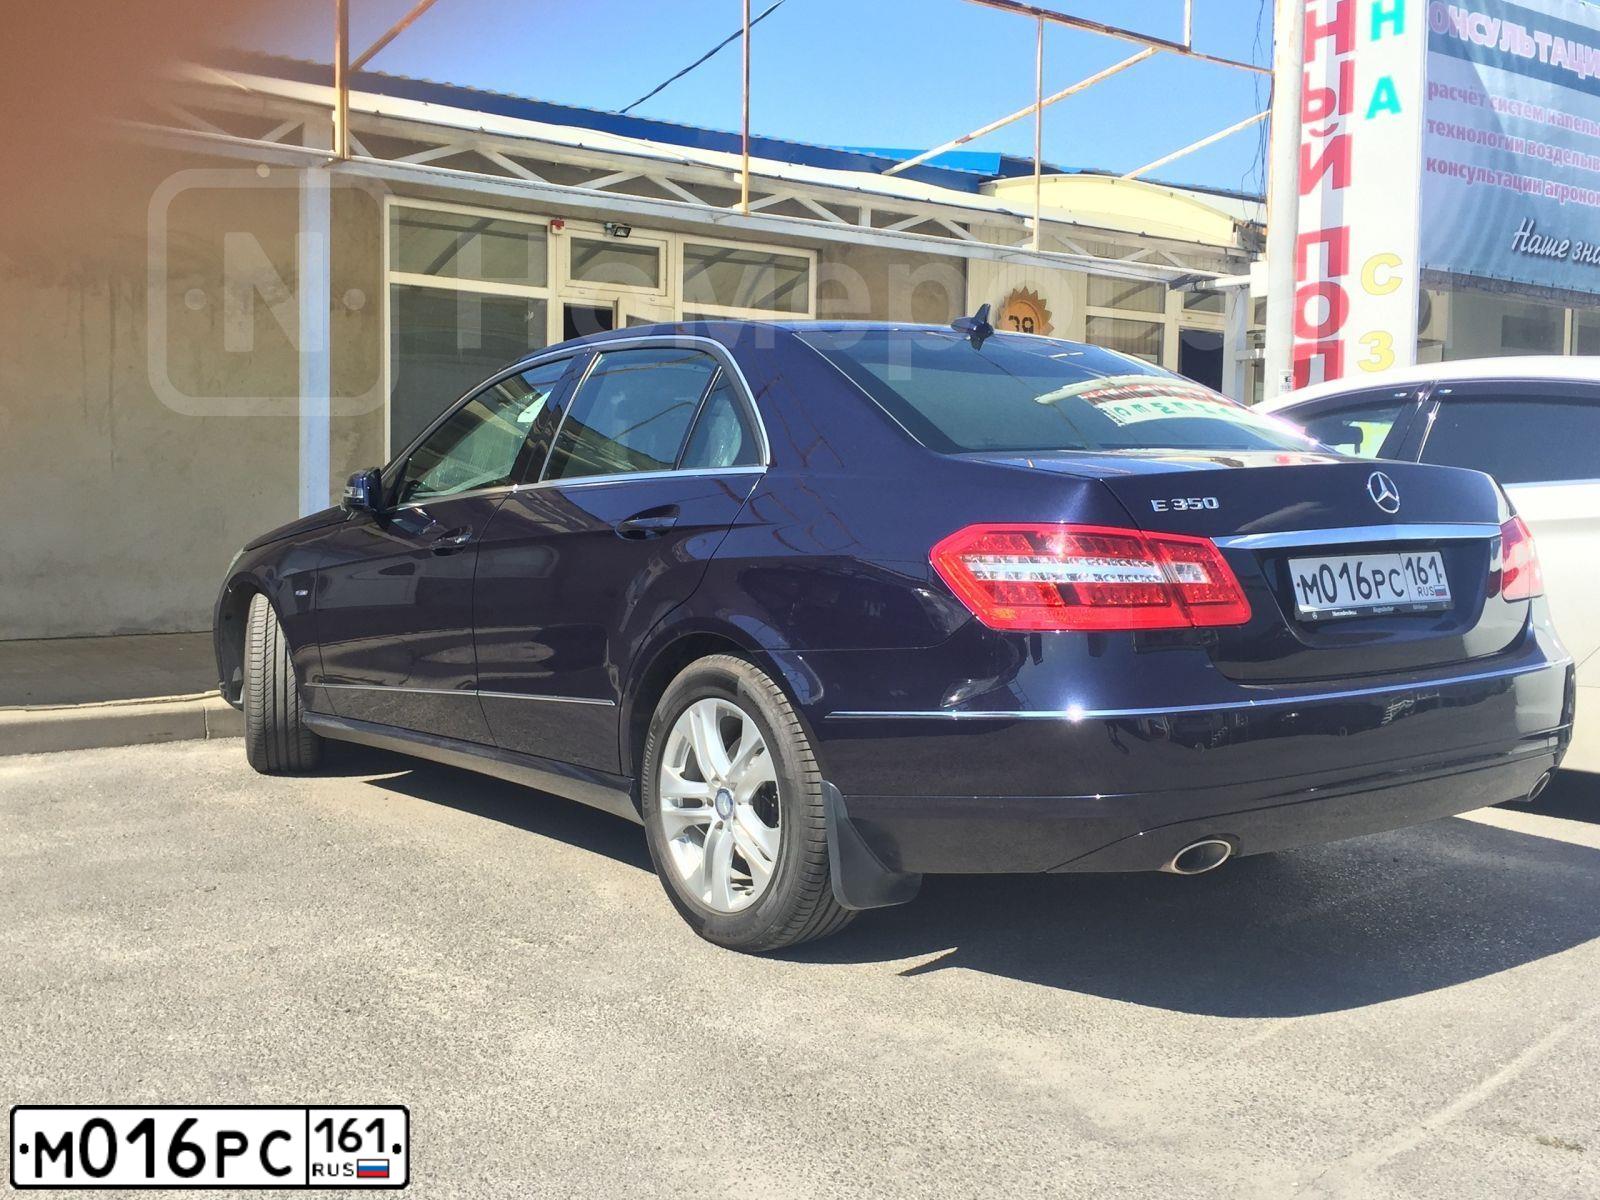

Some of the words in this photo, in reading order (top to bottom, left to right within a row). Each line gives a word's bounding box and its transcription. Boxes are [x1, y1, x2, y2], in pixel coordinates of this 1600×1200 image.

[1298, 0, 1356, 196] НЫЙ
[1489, 95, 1545, 123] систем
[1426, 118, 1525, 155] технологии
[1426, 157, 1543, 195] консультации
[1511, 216, 1570, 258] Наше
[1151, 500, 1169, 512] E
[1171, 497, 1219, 511] 350
[1405, 556, 1441, 586] 161
[1418, 587, 1435, 597] RUS
